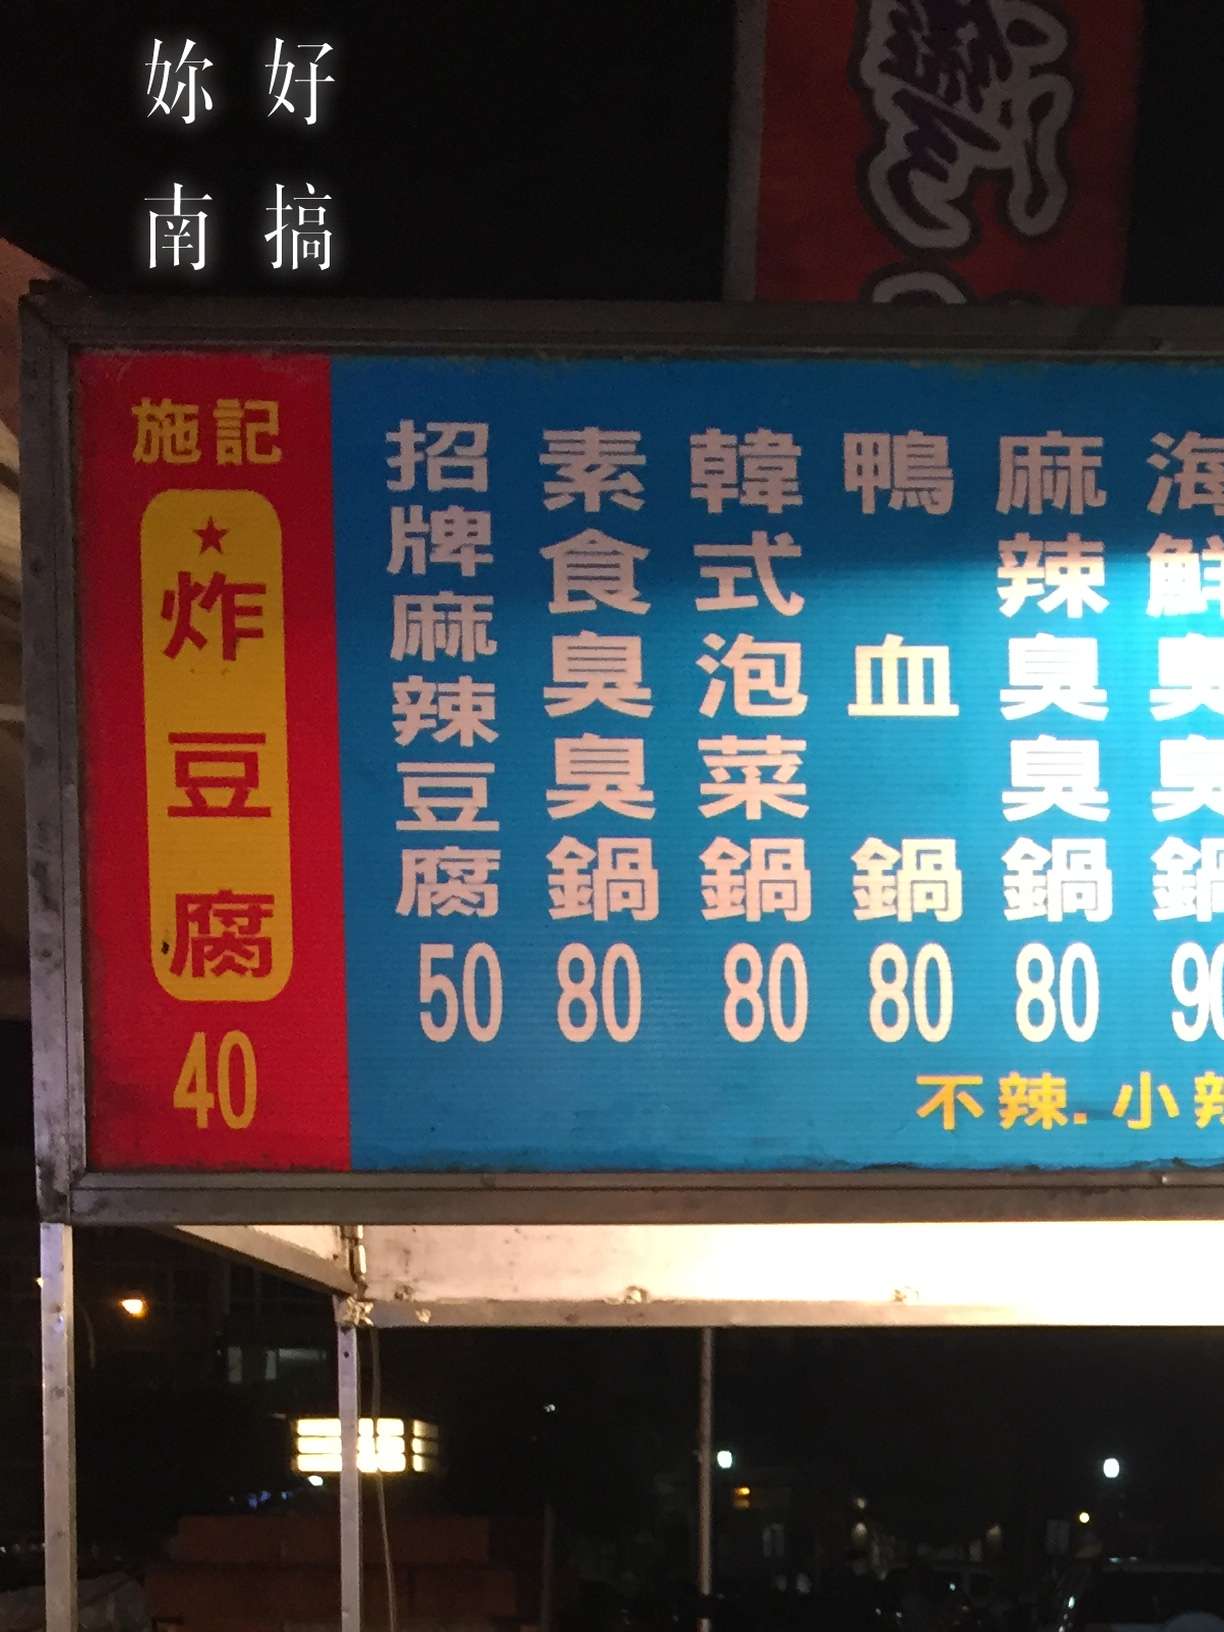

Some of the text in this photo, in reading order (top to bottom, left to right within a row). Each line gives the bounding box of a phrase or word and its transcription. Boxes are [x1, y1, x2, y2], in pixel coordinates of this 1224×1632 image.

[132, 397, 282, 466] 施記
[386, 420, 501, 917] 招牌麻辣豆腐
[540, 427, 659, 920] 素食臭臭鍋
[690, 428, 811, 921] 韓式泡菜鍋
[996, 431, 1112, 922] 麻辣臭臭鍋
[161, 569, 274, 979] 炸豆腐
[420, 943, 503, 1042] 50
[557, 943, 642, 1042] 80
[724, 943, 808, 1043] 80
[869, 943, 953, 1042] 80
[1016, 942, 1099, 1042] 80
[172, 1029, 258, 1130] 40
